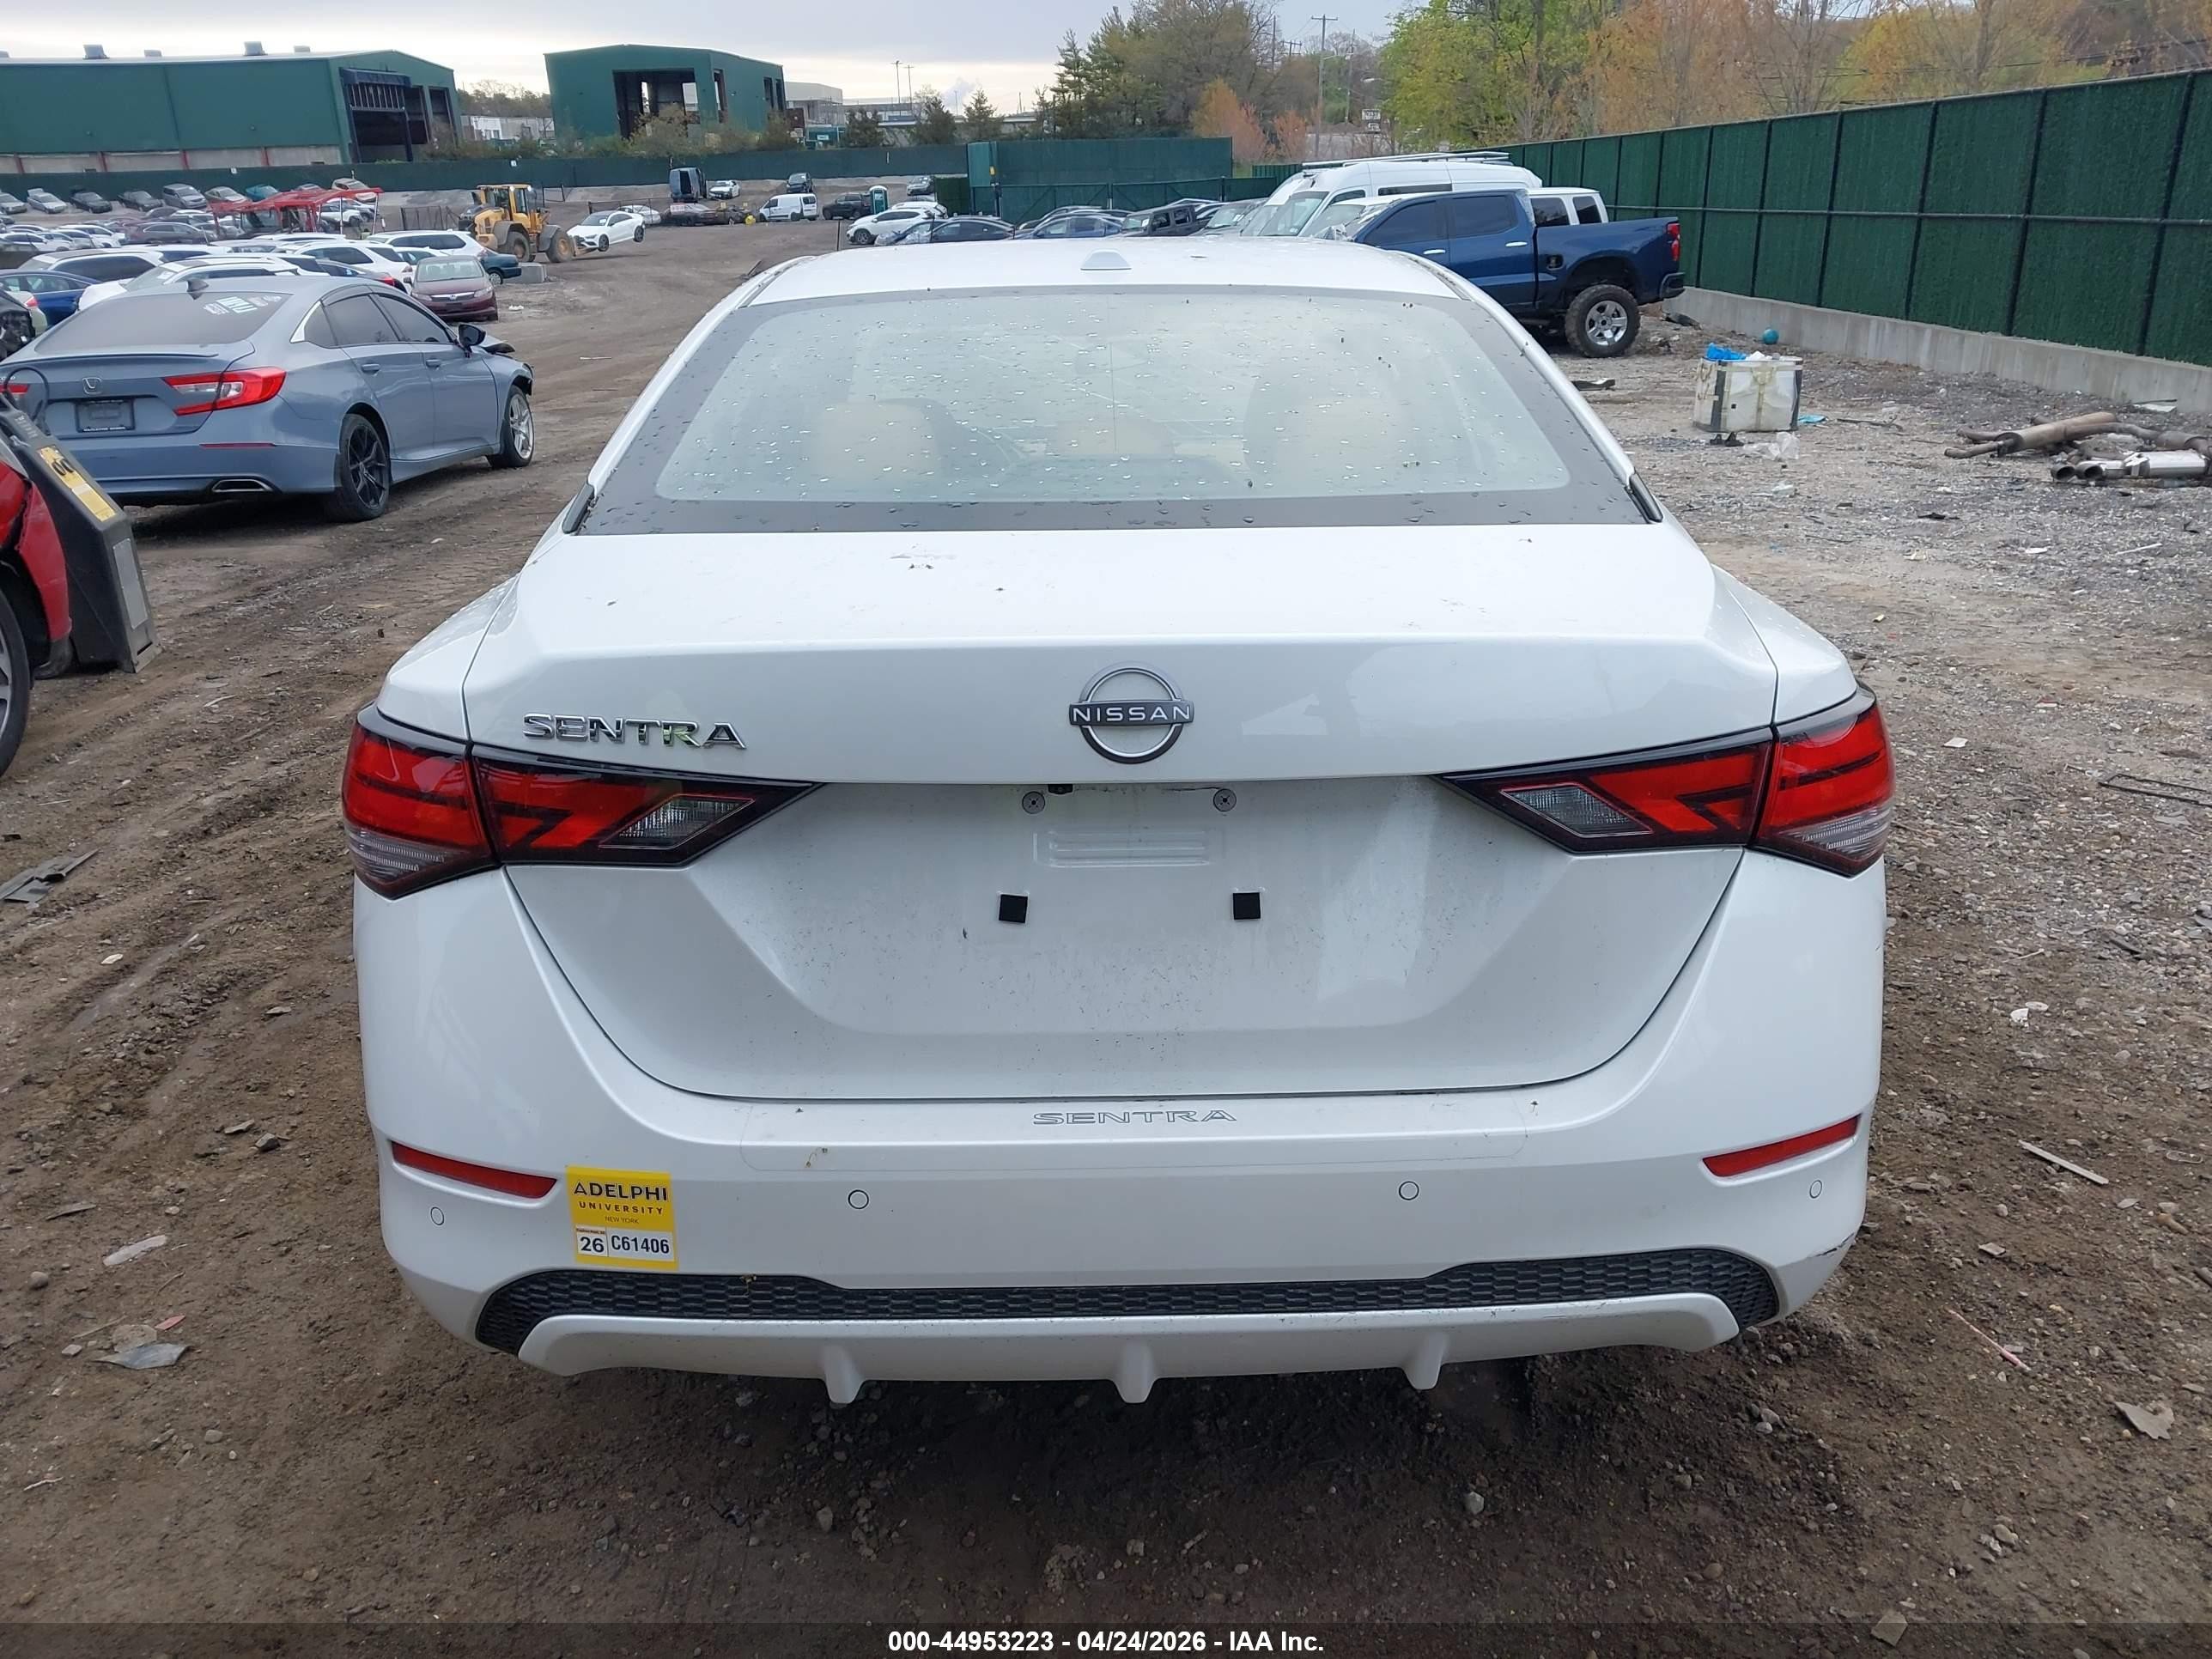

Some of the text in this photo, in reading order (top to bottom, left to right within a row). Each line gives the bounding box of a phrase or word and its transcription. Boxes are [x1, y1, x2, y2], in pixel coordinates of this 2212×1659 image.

[1073, 706, 1190, 722] NISSAN
[522, 713, 746, 750] SENTRA
[1033, 1109, 1237, 1125] SENTRA
[574, 1182, 668, 1201] ADELPHI
[579, 1201, 663, 1214] UNIVERSITY
[580, 1235, 670, 1254] 26 C61406
